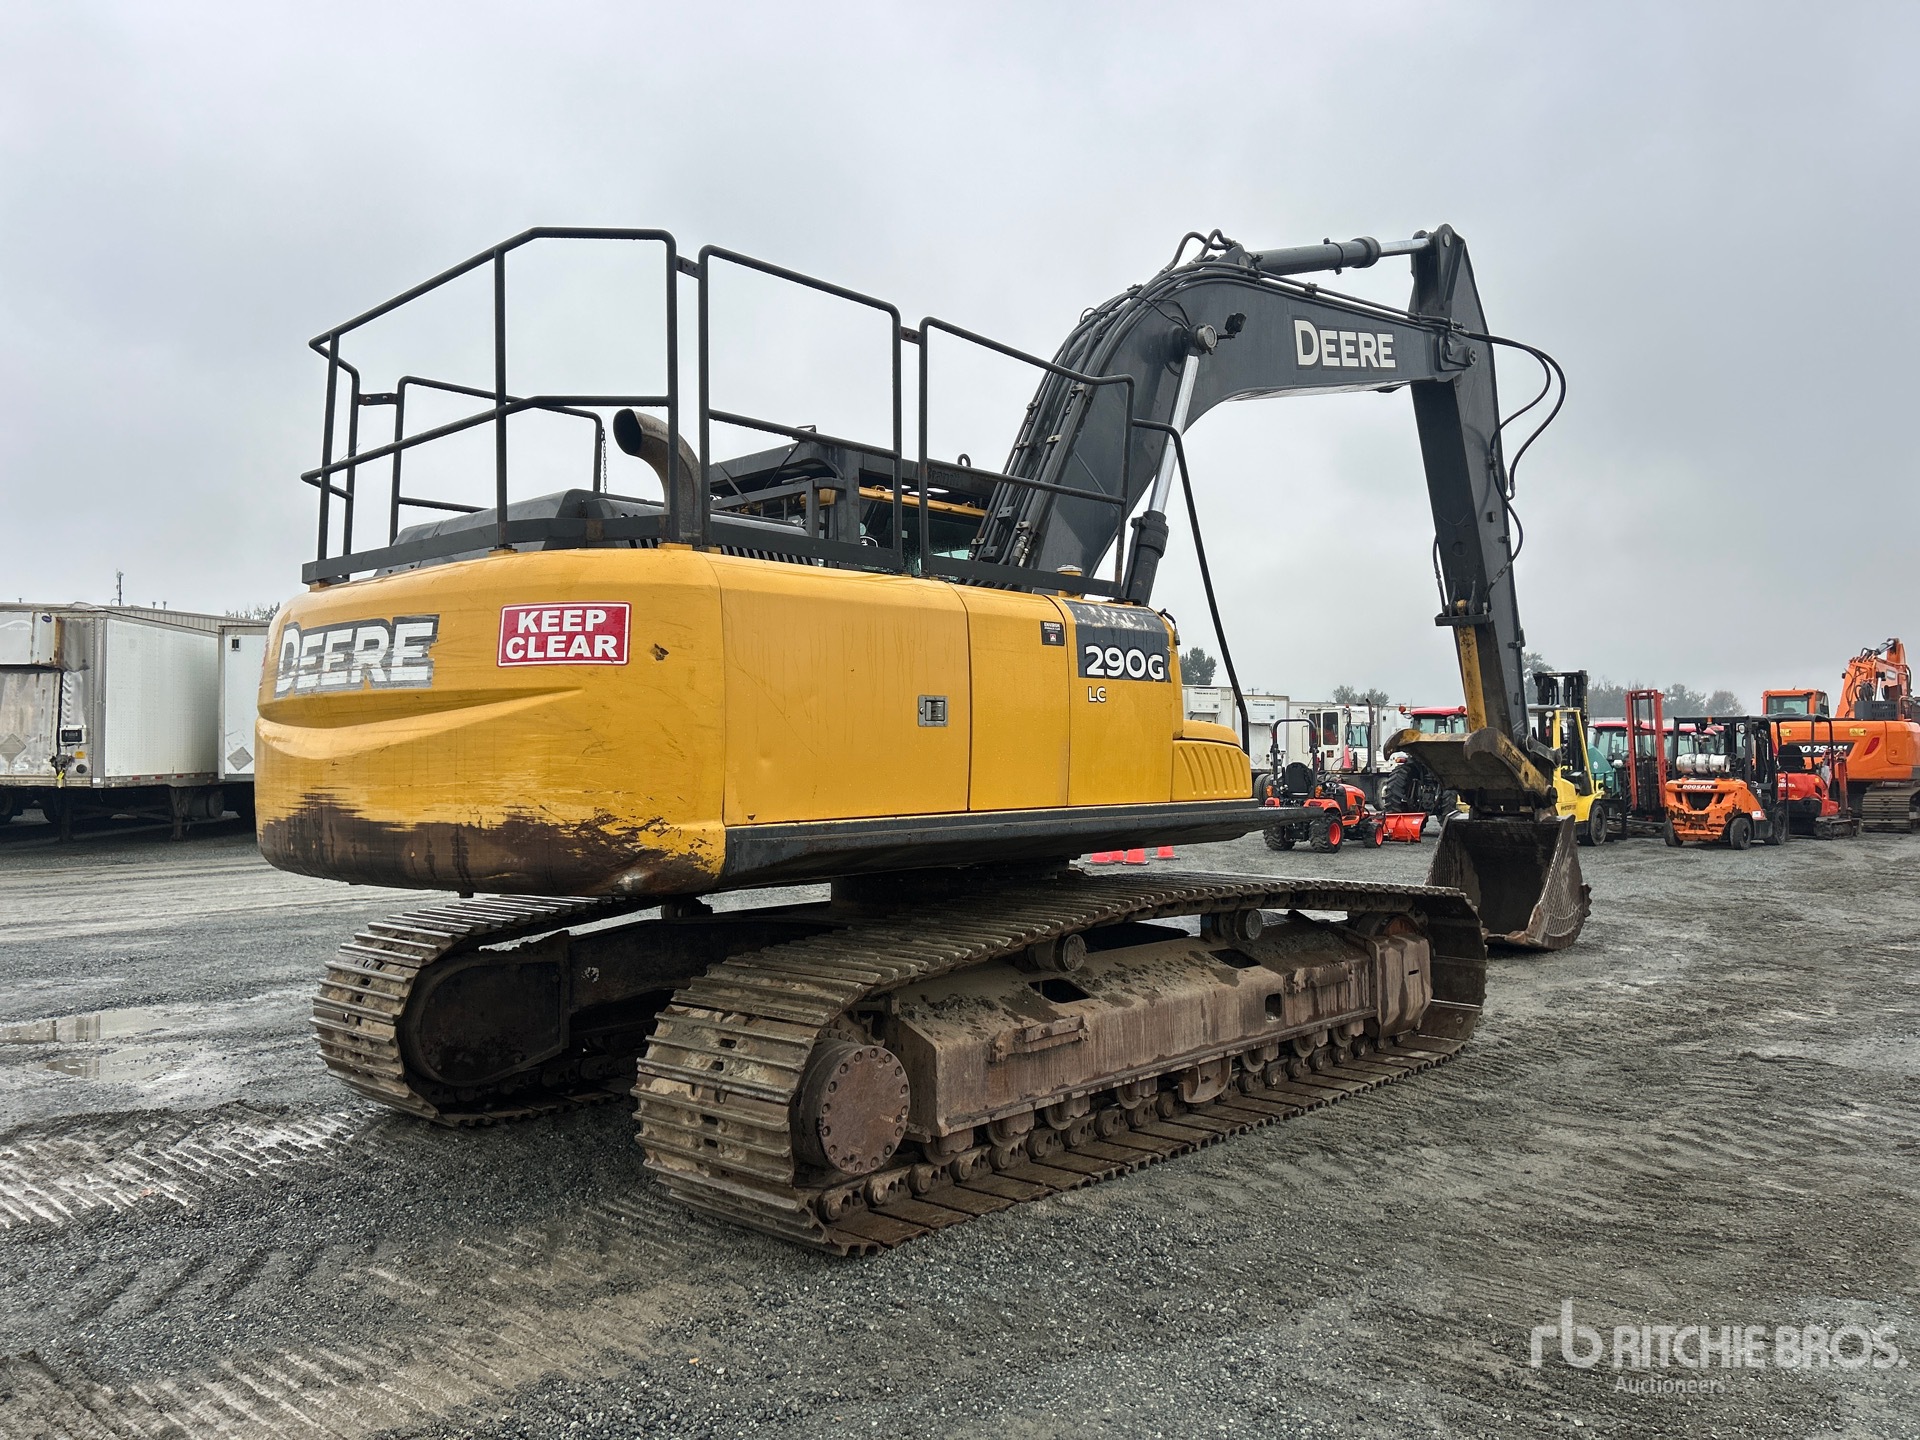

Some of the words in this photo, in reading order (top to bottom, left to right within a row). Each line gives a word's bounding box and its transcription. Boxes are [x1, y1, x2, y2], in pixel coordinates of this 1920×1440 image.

[1294, 319, 1396, 368] DEERE
[517, 609, 607, 634] KEEP
[275, 622, 434, 693] DEERE
[505, 634, 619, 659] CLEAR
[1085, 645, 1165, 680] 290G
[1088, 686, 1107, 702] LC
